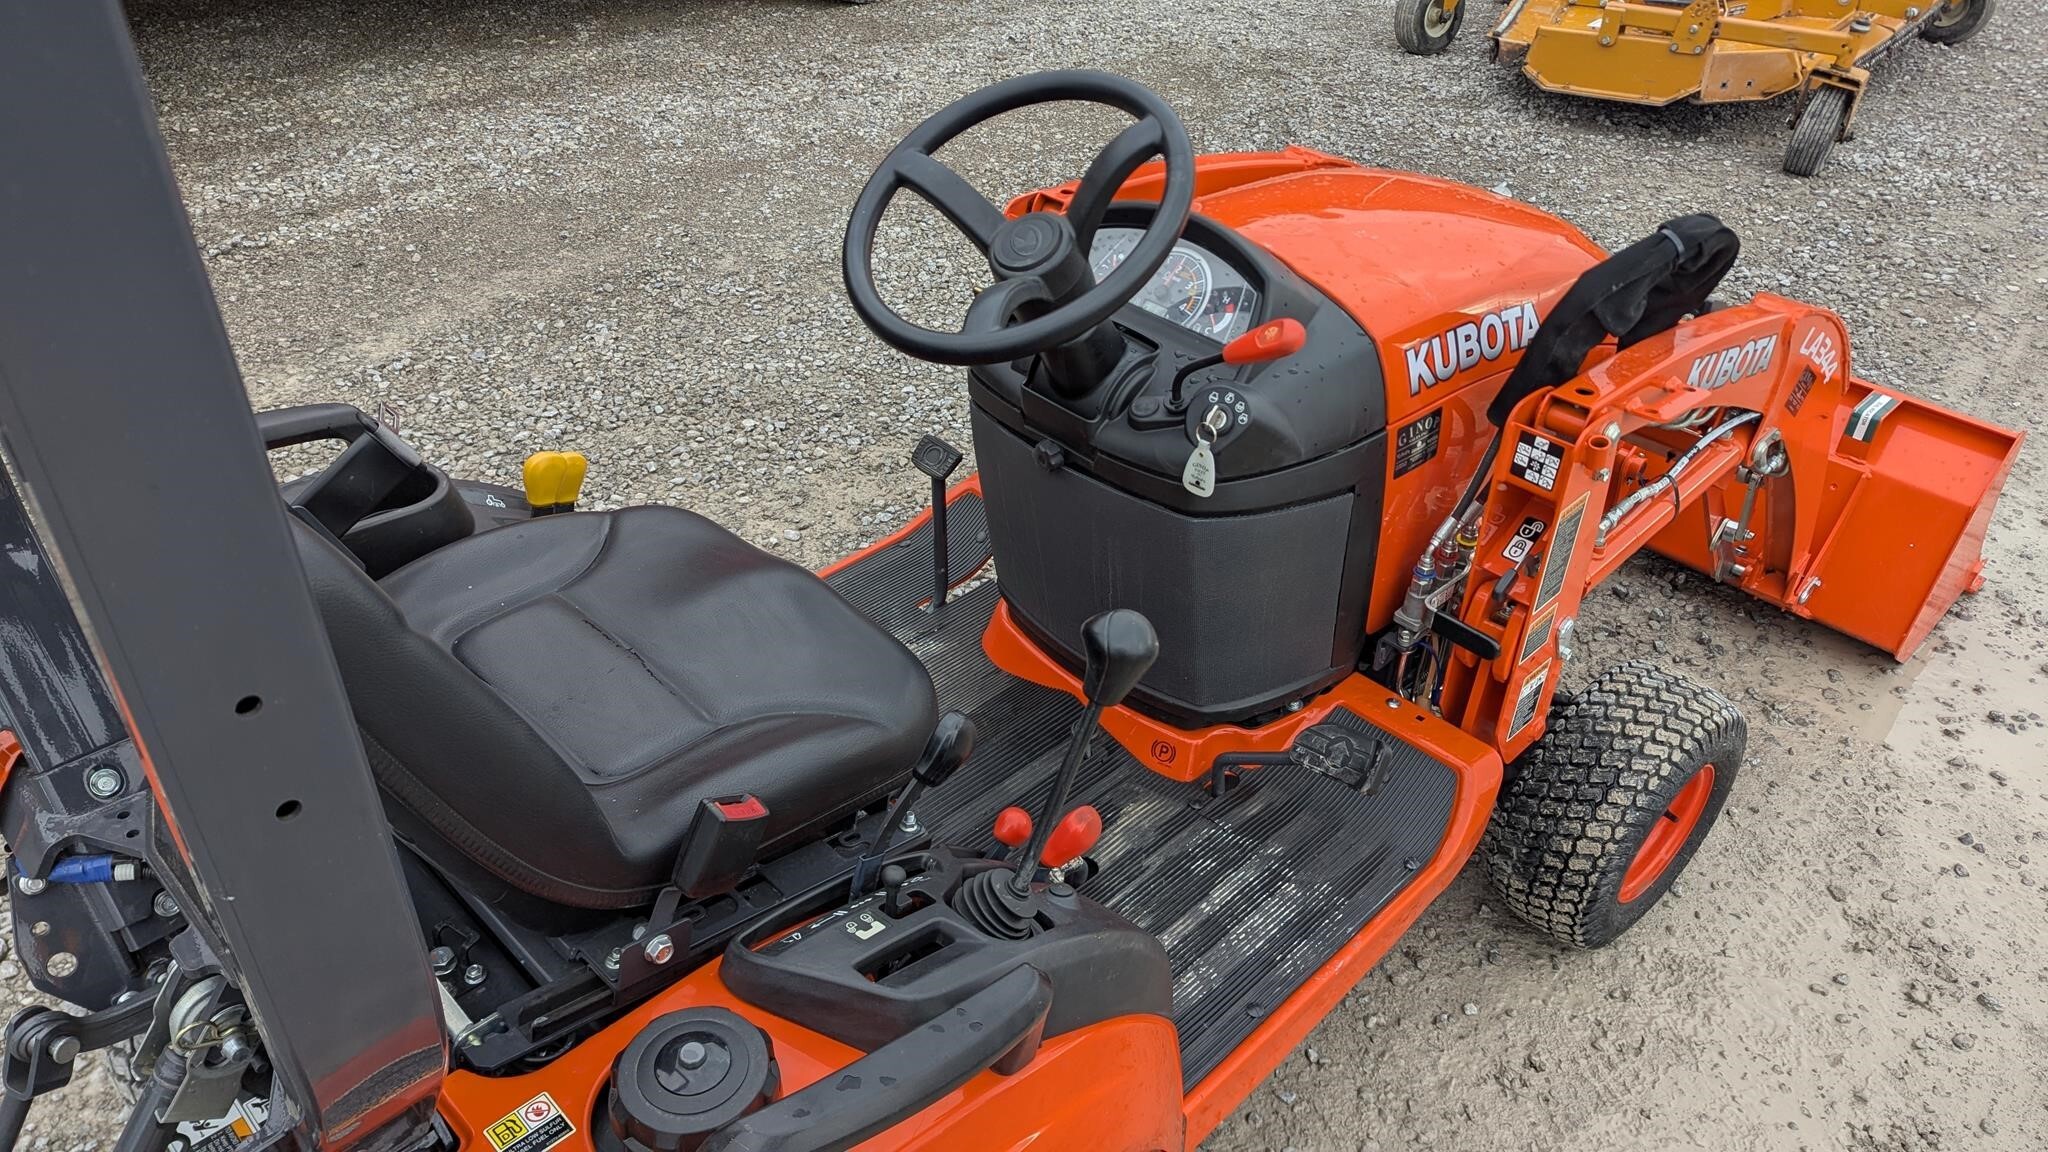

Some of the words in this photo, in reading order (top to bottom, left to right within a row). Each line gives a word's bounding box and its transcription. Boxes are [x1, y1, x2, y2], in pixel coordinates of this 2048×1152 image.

[1405, 300, 1541, 398] KUBOTA
[1686, 333, 1778, 390] KUBOTA
[524, 1131, 540, 1144] LOW
[538, 1117, 562, 1135] SULFUR
[532, 1133, 550, 1146] FUEL
[548, 1121, 565, 1135] ONLY
